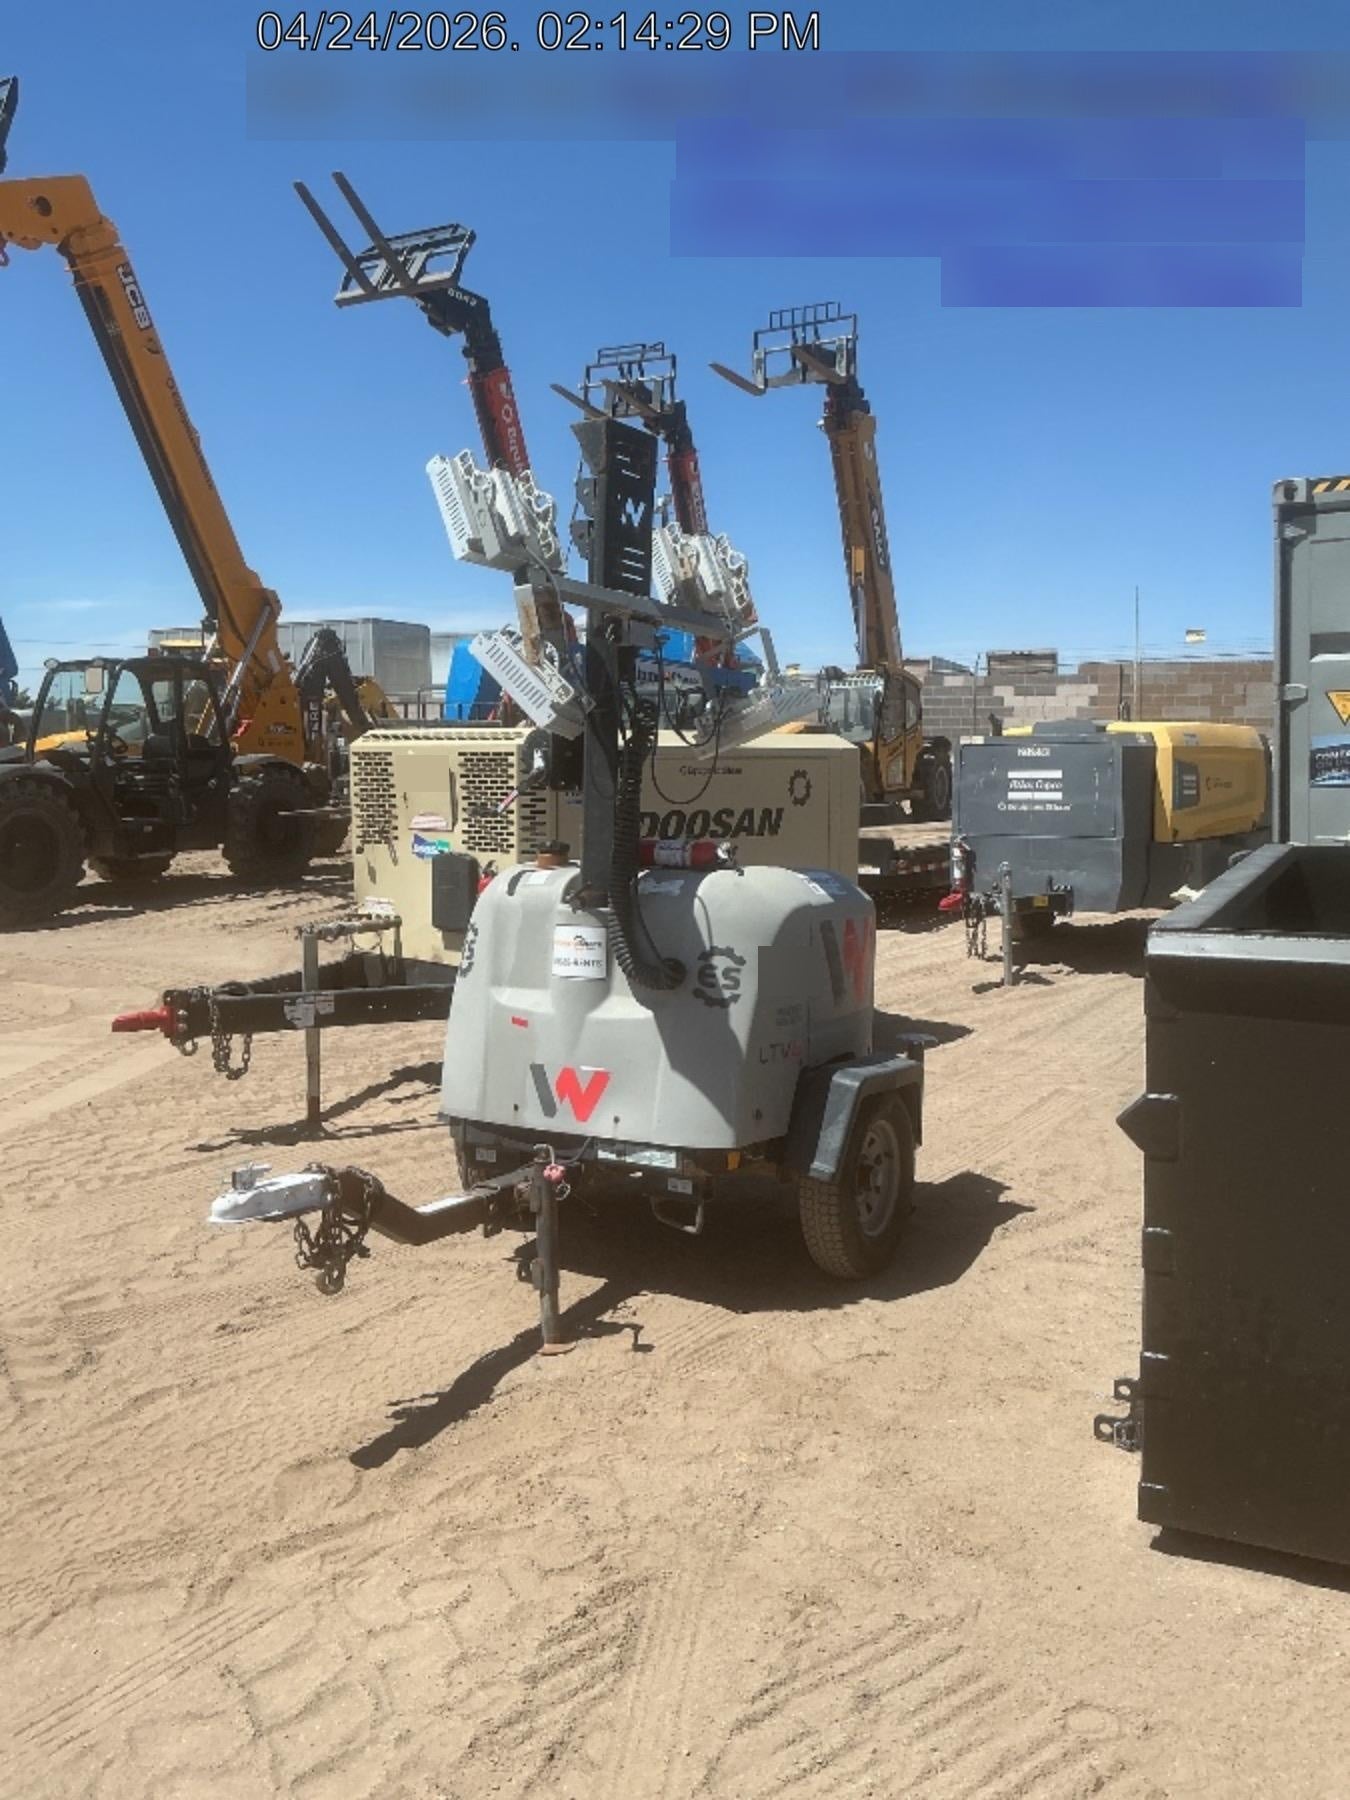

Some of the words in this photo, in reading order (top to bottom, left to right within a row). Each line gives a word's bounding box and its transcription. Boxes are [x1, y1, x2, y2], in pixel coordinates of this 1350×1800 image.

[116, 264, 151, 330] JCB
[640, 807, 784, 840] DOOSAN
[697, 963, 742, 991] ES
